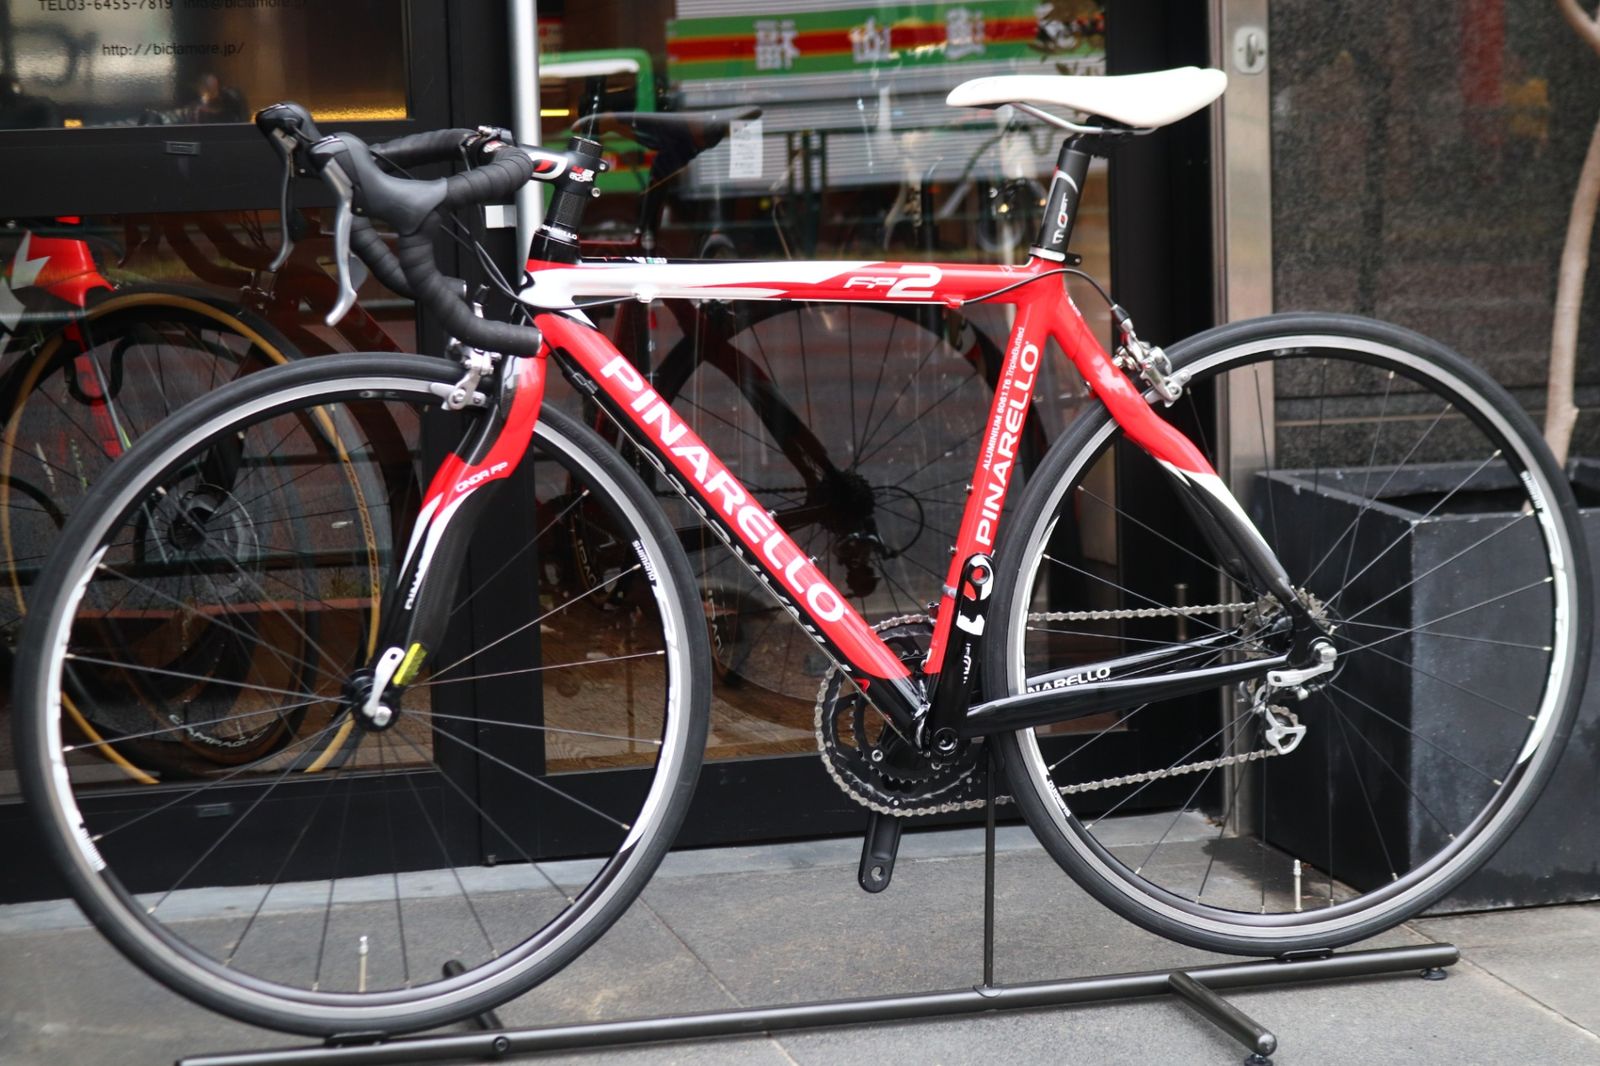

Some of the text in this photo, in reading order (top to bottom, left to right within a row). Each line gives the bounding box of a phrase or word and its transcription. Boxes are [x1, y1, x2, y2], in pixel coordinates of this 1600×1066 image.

[843, 265, 943, 298] FP2
[600, 355, 846, 622] PINARELLO
[976, 342, 1040, 546] PINARELLO
[982, 414, 1003, 471] ALUMINIUM
